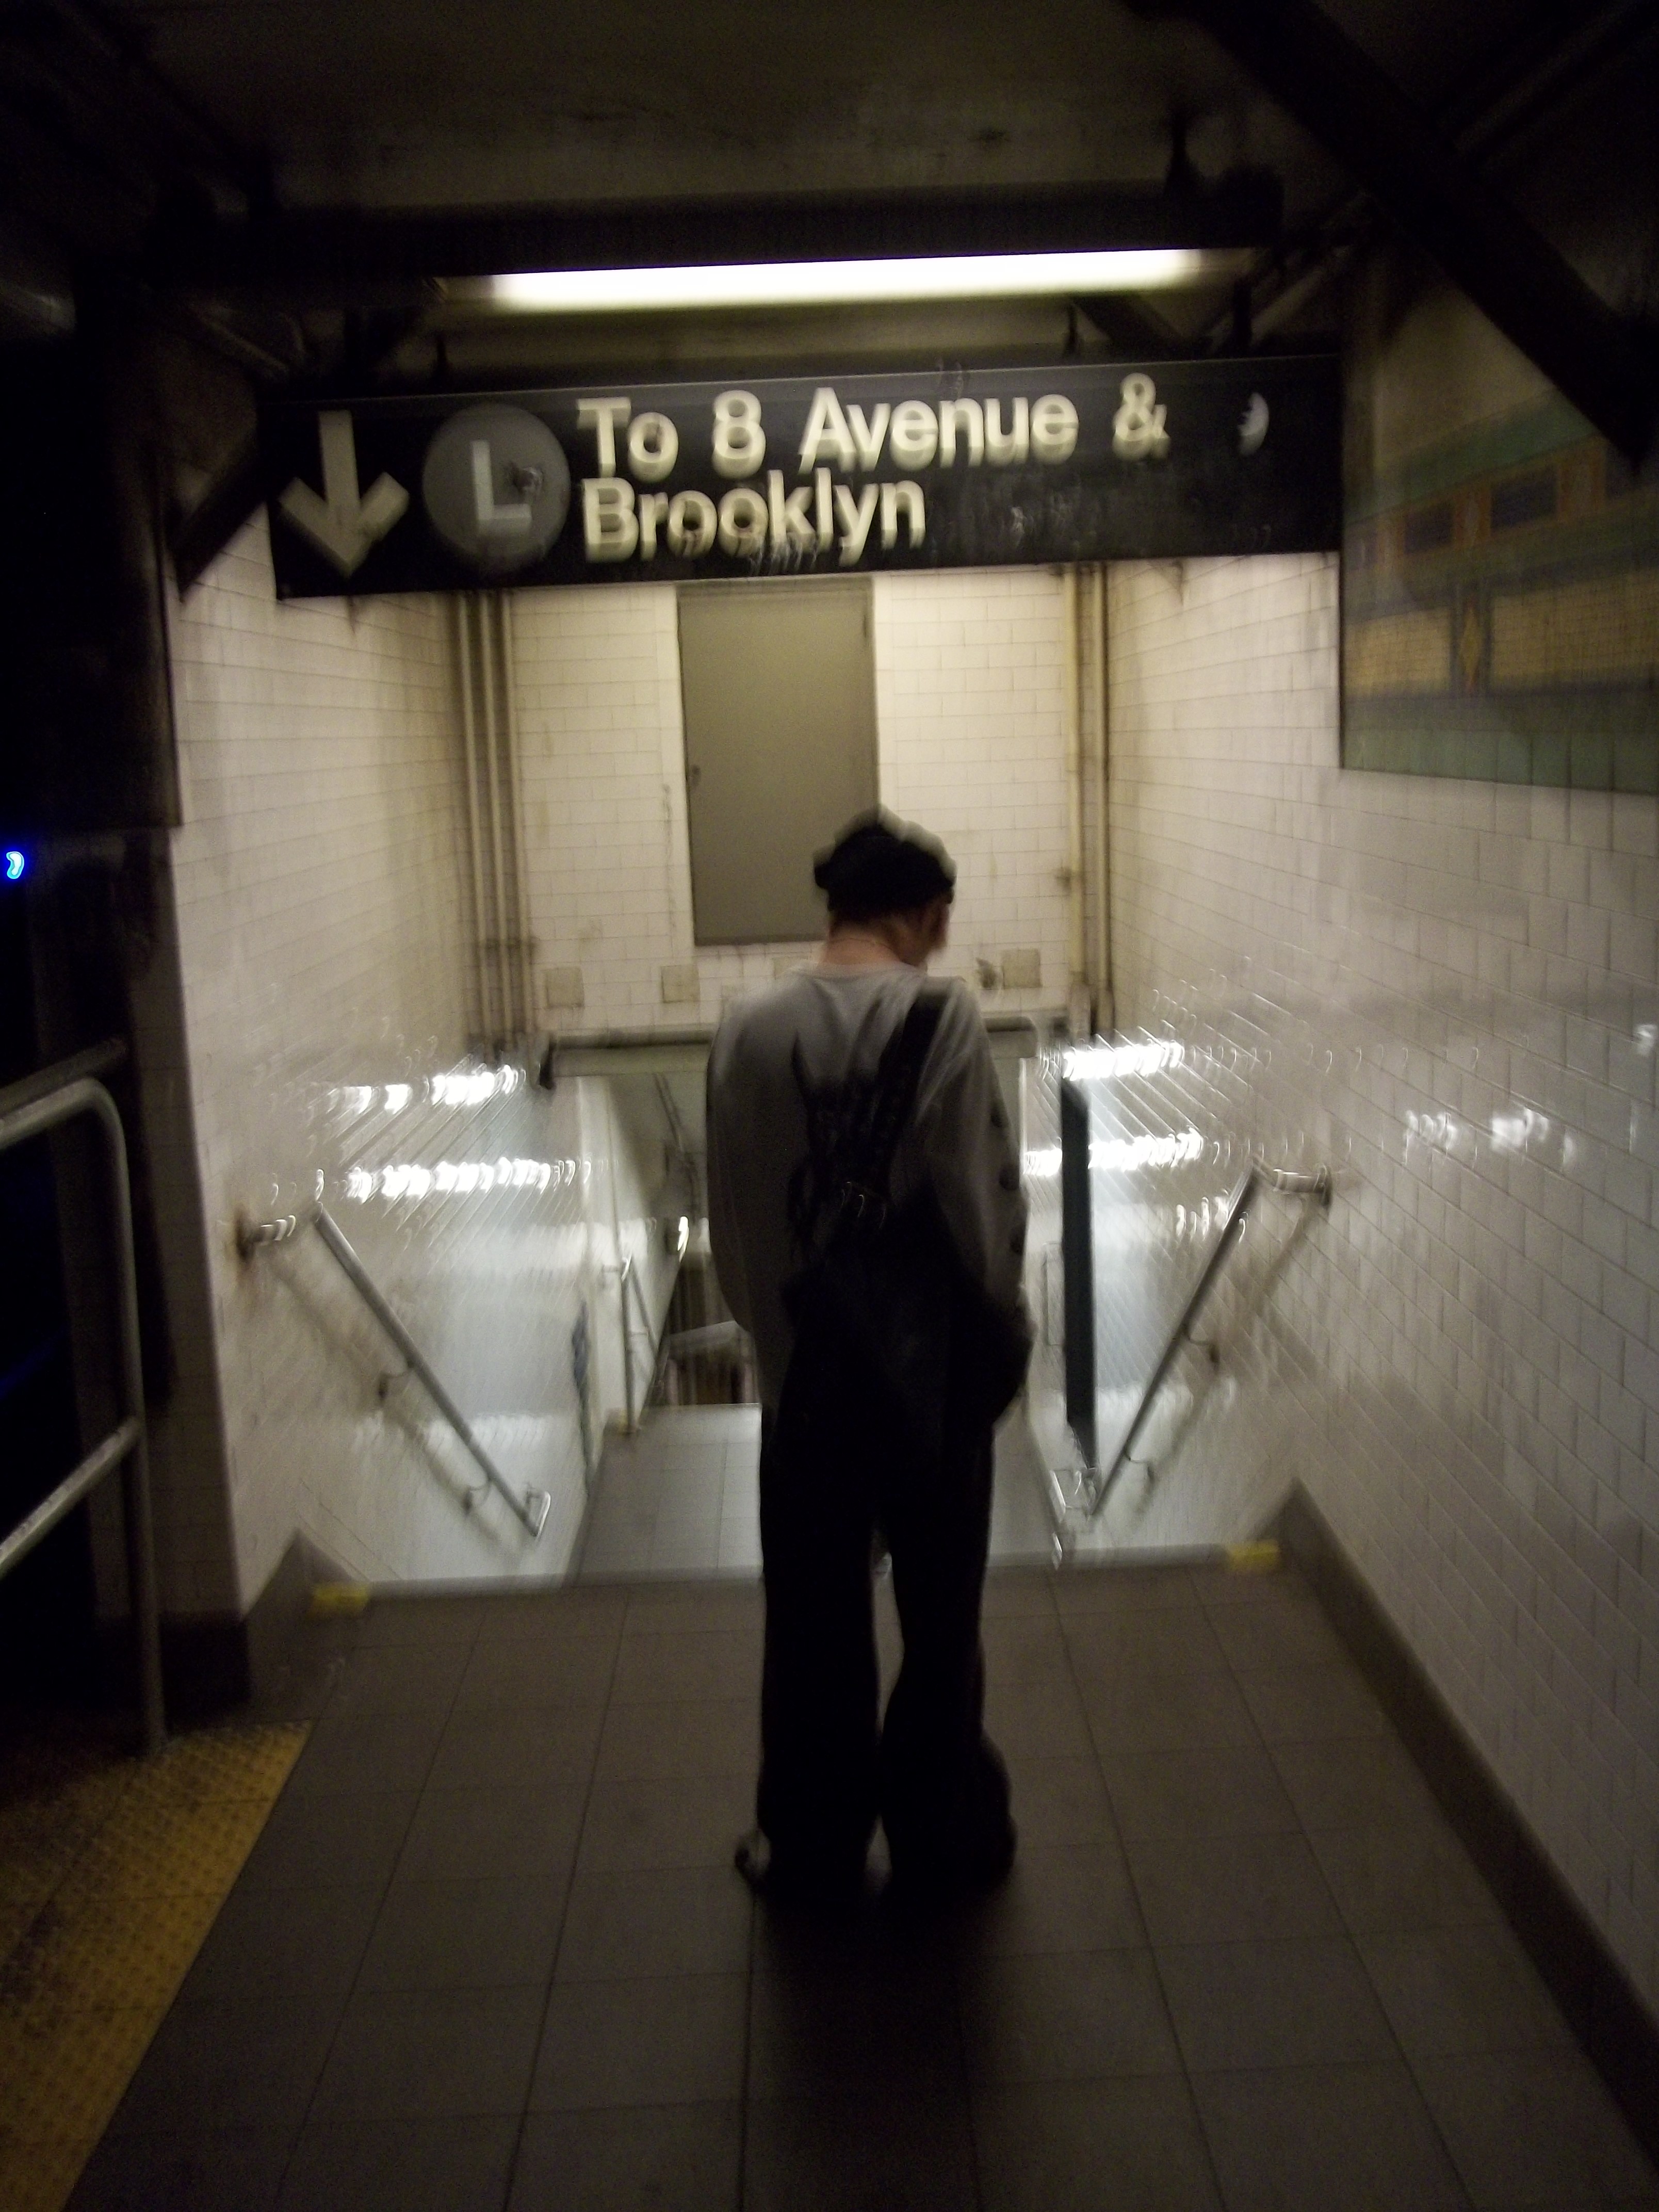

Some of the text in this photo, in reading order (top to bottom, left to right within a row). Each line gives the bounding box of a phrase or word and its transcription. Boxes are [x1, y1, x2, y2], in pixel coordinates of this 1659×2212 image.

[576, 372, 1171, 482] To 8 Avenue &
[470, 440, 532, 535] L
[581, 467, 926, 566] Brooklyn
